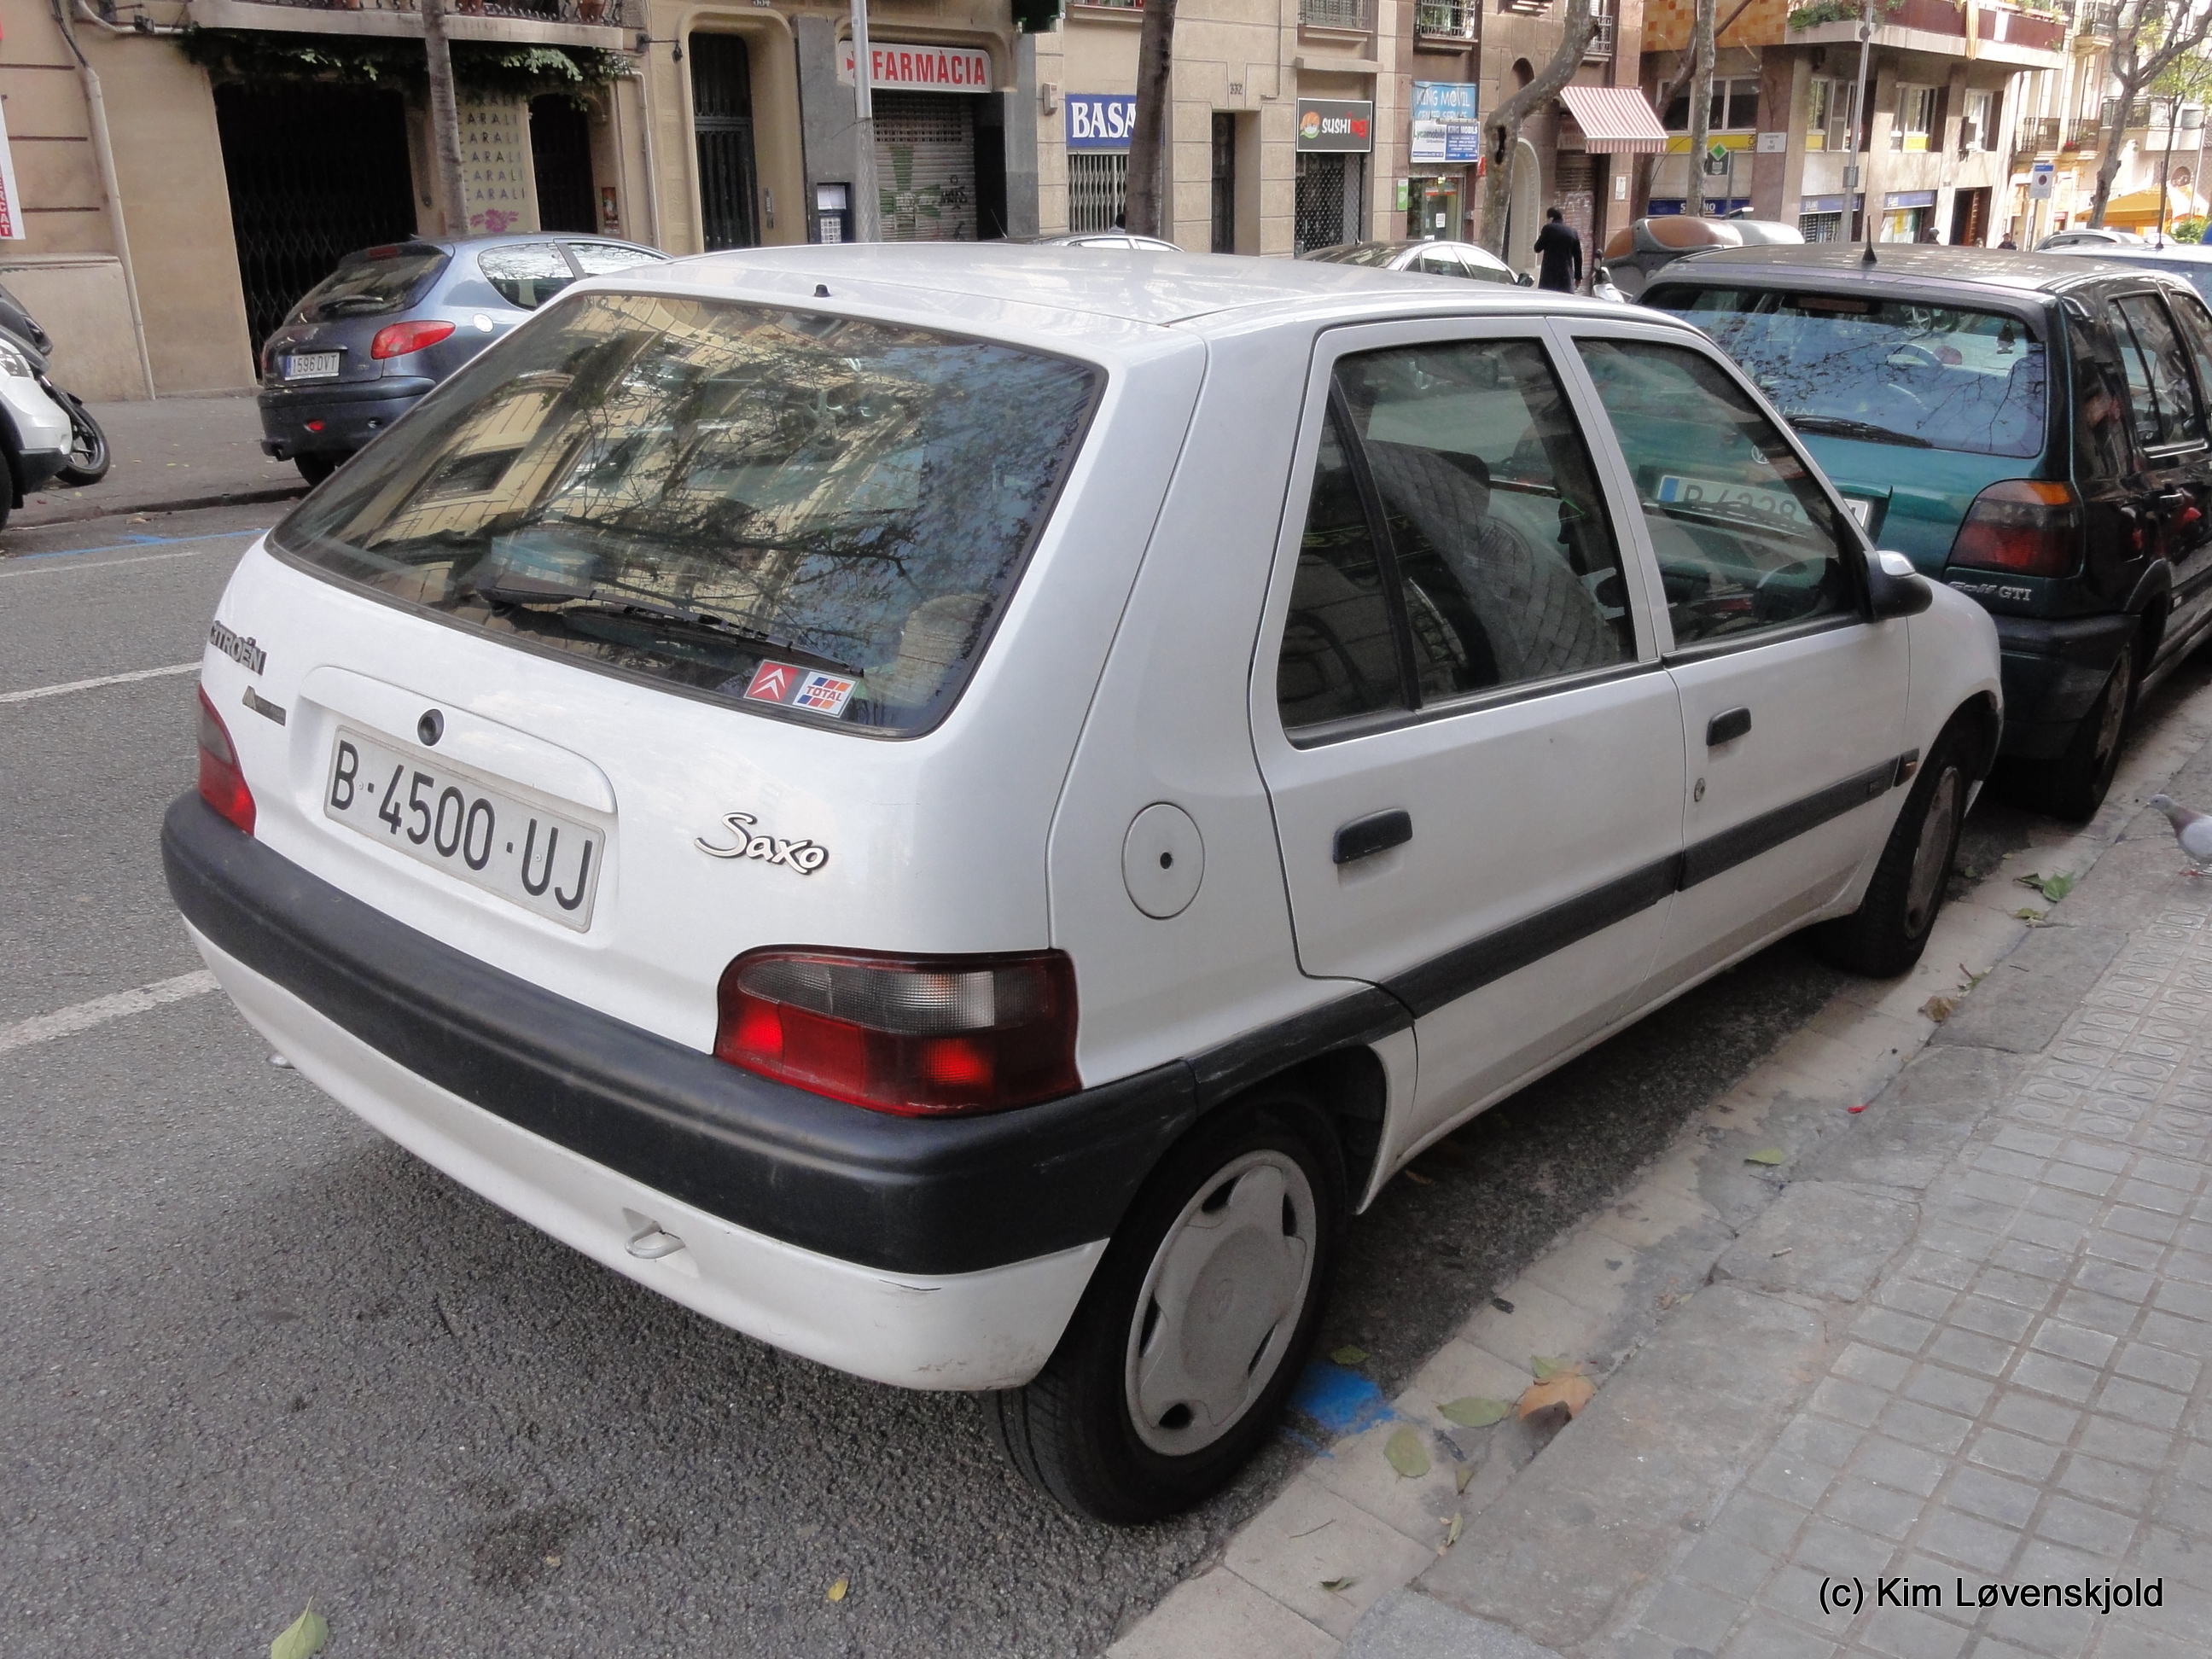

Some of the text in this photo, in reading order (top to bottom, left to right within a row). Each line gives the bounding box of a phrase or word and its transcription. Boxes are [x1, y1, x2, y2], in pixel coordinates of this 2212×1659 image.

[872, 50, 987, 85] FARMÀCIA
[457, 112, 517, 125] ARALI
[1071, 102, 1137, 138] BASA
[459, 131, 520, 144] ARALI
[461, 151, 521, 163] ARALI
[463, 170, 523, 182] ARALI
[465, 188, 526, 201] ARALI
[293, 355, 337, 374] 1596 DVT
[1998, 585, 2032, 601] GTI
[806, 684, 843, 702] TOTAL
[693, 811, 830, 875] Saxo
